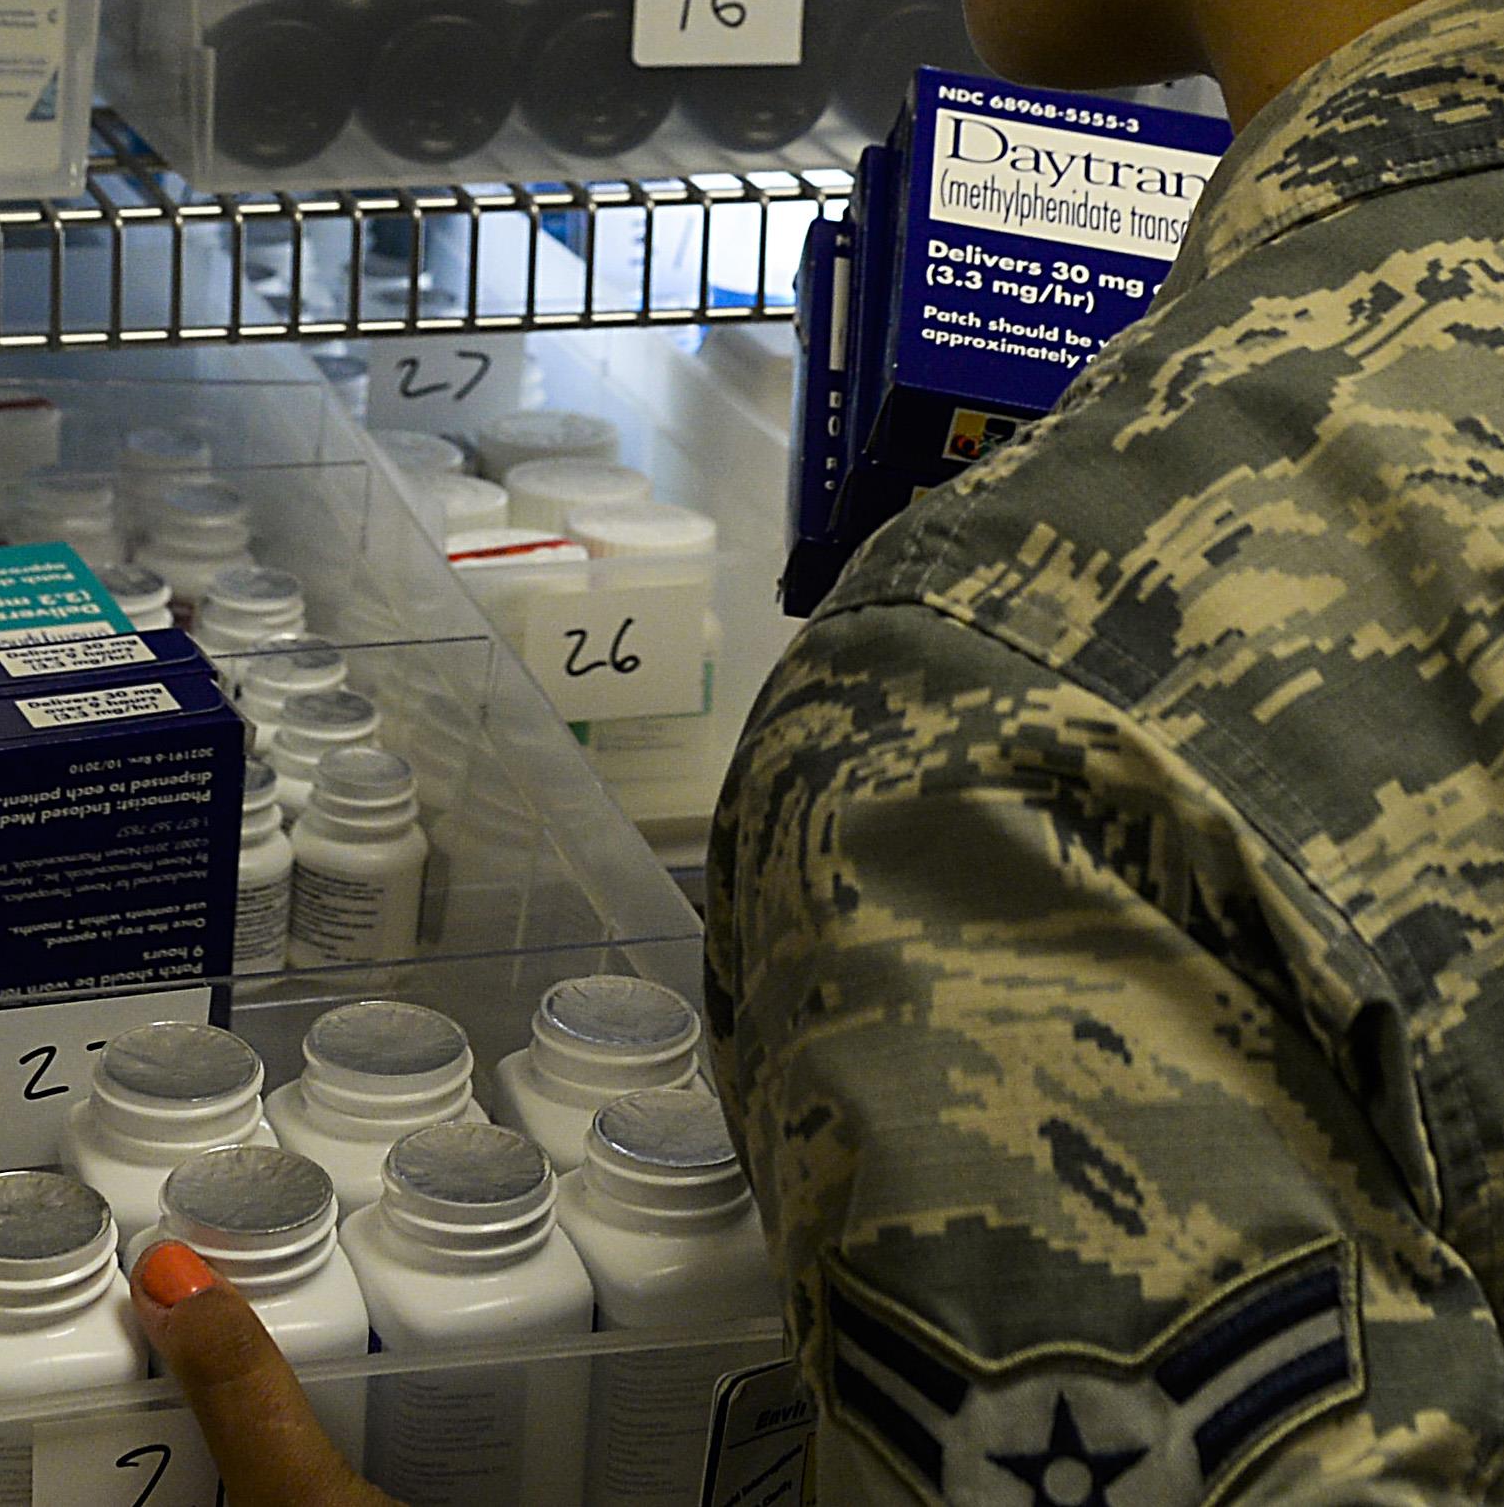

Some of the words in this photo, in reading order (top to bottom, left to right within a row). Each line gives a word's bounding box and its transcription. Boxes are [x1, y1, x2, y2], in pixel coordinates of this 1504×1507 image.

[939, 86, 984, 106] NDC
[989, 95, 1139, 133] 68968-5555-3
[946, 116, 1208, 200] Daytran
[940, 168, 1121, 234] (methylphenidate
[928, 240, 1042, 276] Delivers
[1051, 261, 1090, 284] 30
[1098, 272, 1144, 298] mg
[926, 264, 982, 290] (3.3
[993, 280, 1094, 314] mg/hr)
[924, 305, 981, 328] Patch
[988, 317, 1059, 342] should
[1065, 329, 1092, 347] be
[922, 327, 1080, 368] approximately
[396, 350, 492, 400] 27
[6, 646, 75, 658] Delivers
[110, 639, 138, 647] mg
[83, 647, 132, 657] hours
[565, 618, 643, 676] 26
[28, 696, 99, 709] Delivers
[107, 690, 127, 698] 30
[134, 687, 162, 695] mg
[45, 705, 82, 714] over
[107, 696, 157, 706] hours
[69, 758, 122, 774] 10/2010
[109, 782, 125, 794] to
[130, 770, 213, 794] dispensed
[66, 784, 104, 802] each
[116, 789, 211, 811] Pharmacist:
[41, 801, 111, 824] Enclosed
[78, 911, 121, 927] within
[125, 904, 180, 921] contents
[65, 919, 74, 929] 2
[172, 916, 207, 929] Once
[142, 945, 187, 961] hours
[193, 945, 205, 958] 9
[100, 968, 154, 988] should
[159, 961, 203, 978] Patch
[74, 975, 95, 990] be
